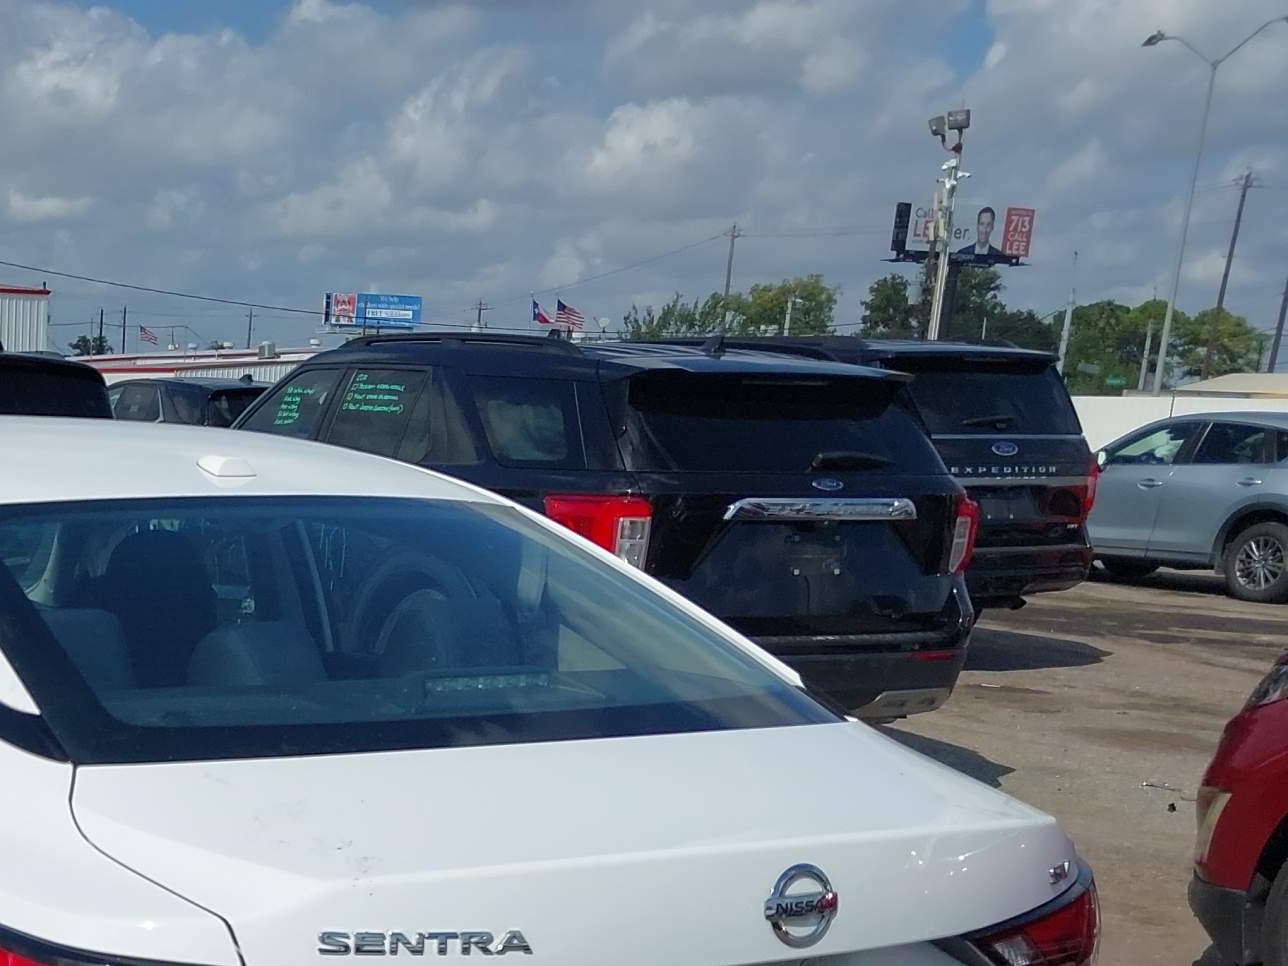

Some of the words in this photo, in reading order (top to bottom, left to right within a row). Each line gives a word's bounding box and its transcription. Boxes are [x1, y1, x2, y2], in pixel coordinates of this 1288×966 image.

[1008, 215, 1031, 232] 713
[1007, 231, 1027, 241] CALL
[1005, 241, 1027, 255] LEE
[950, 466, 1057, 474] EXPEDITION
[774, 892, 838, 915] NISSAN
[318, 930, 534, 956] SENTRA
